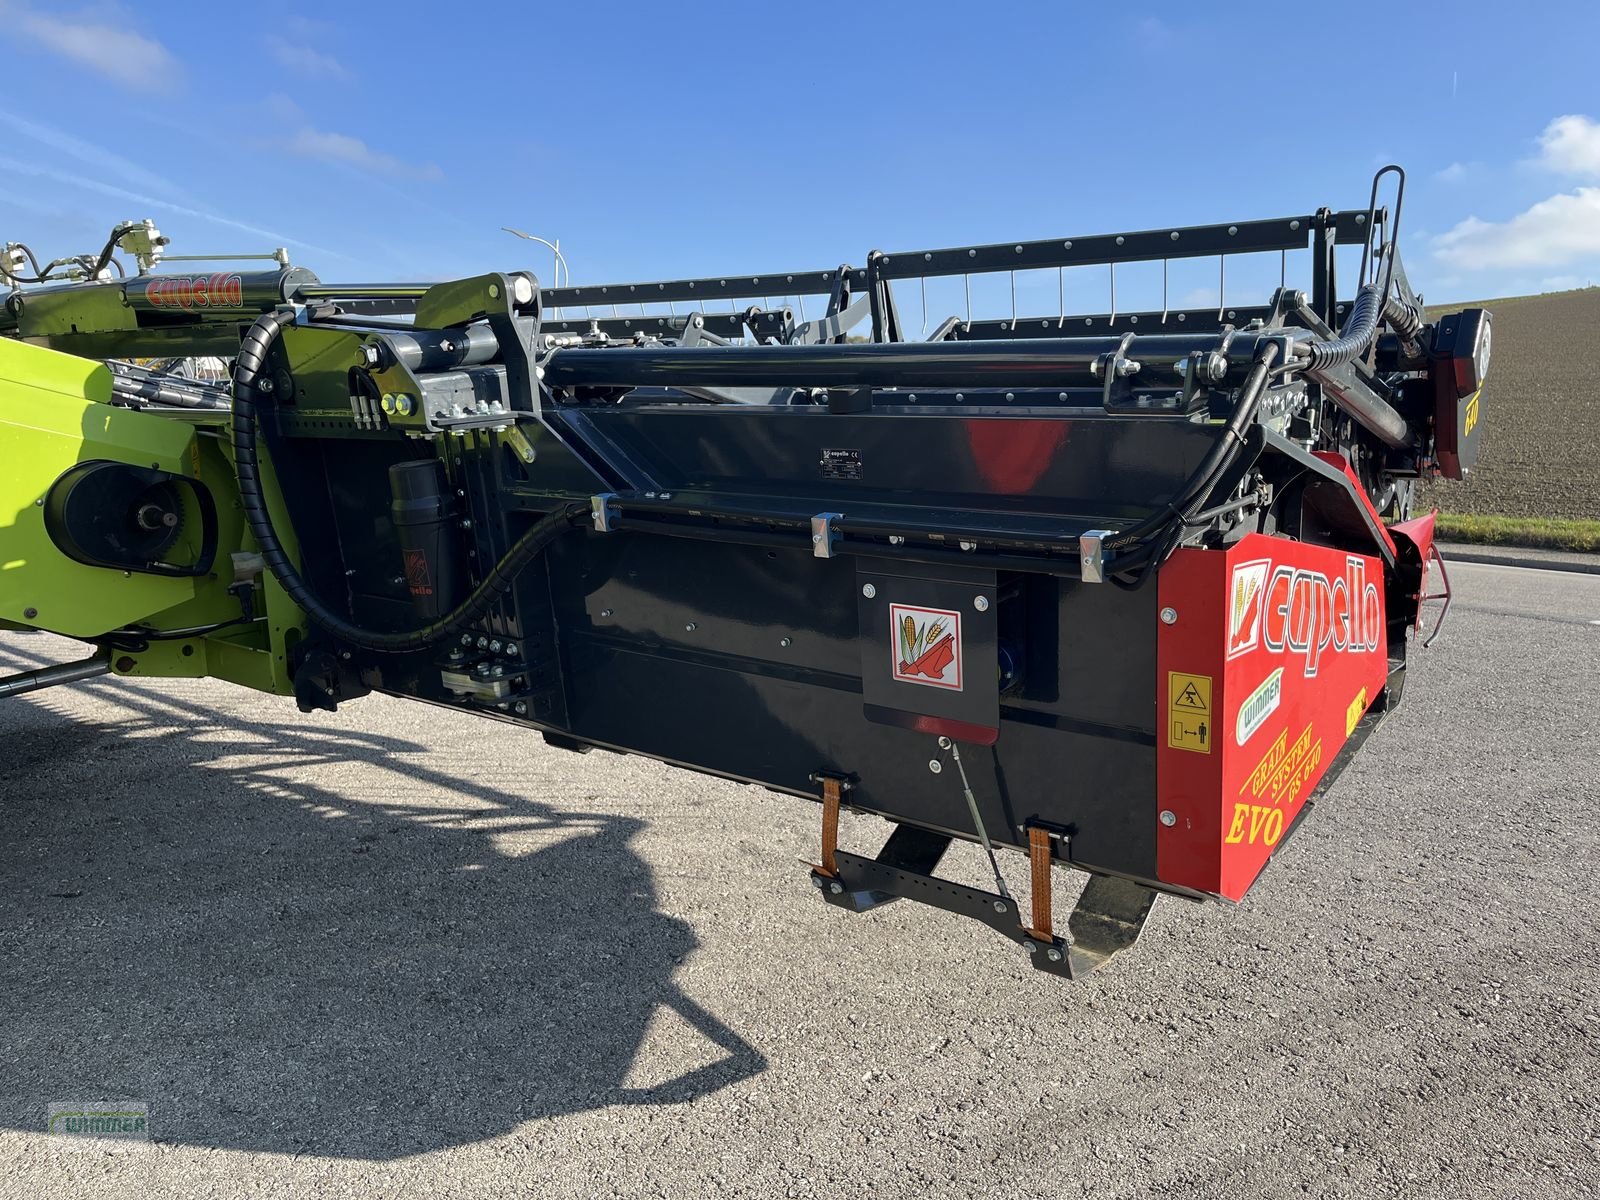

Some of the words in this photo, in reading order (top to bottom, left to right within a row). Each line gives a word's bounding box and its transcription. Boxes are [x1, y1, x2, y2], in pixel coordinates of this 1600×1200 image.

[1244, 677, 1280, 729] WIMMER
[1252, 732, 1288, 796] GRAIN
[1271, 728, 1313, 799] SYSTEM
[1288, 771, 1302, 804] GS
[1304, 744, 1322, 782] 640
[1225, 803, 1284, 847] EVO
